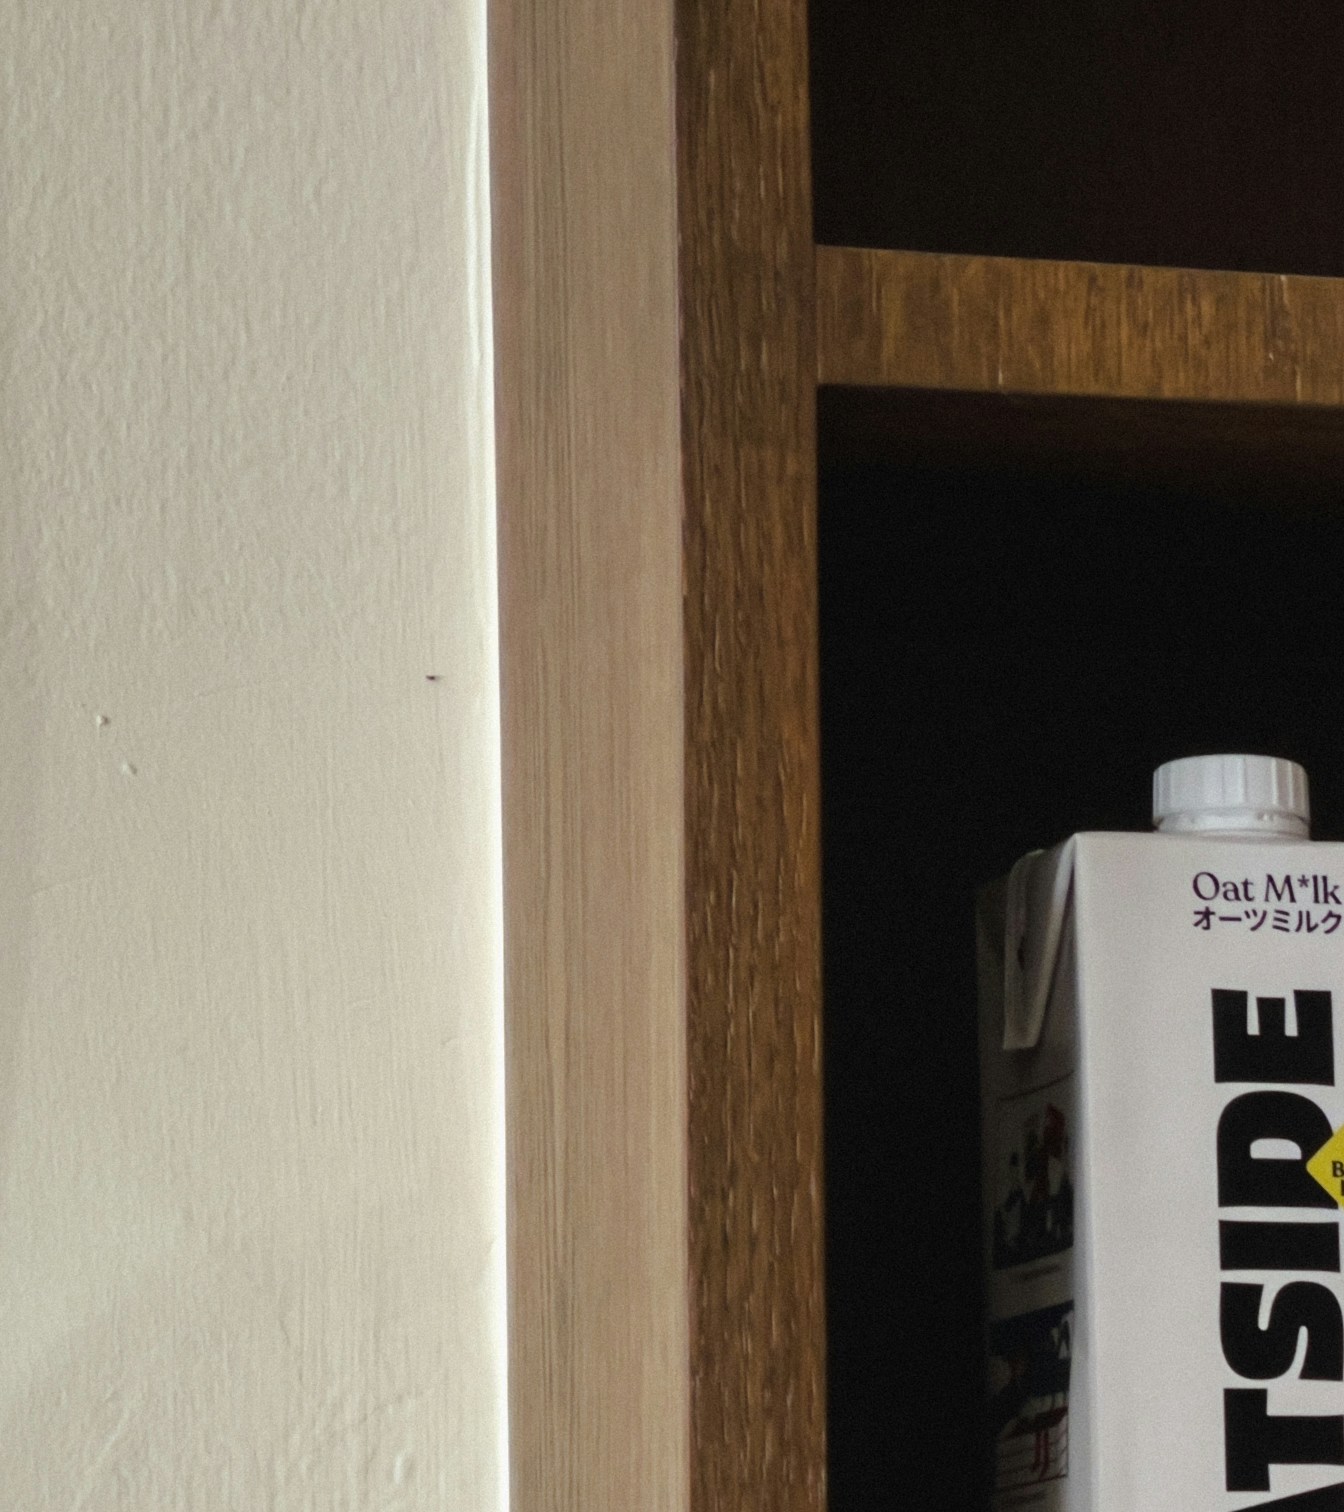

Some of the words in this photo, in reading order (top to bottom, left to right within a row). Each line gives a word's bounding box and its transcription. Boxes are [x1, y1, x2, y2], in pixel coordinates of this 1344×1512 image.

[1192, 871, 1255, 902] Oat
[1193, 906, 1343, 935] オーツミルク
